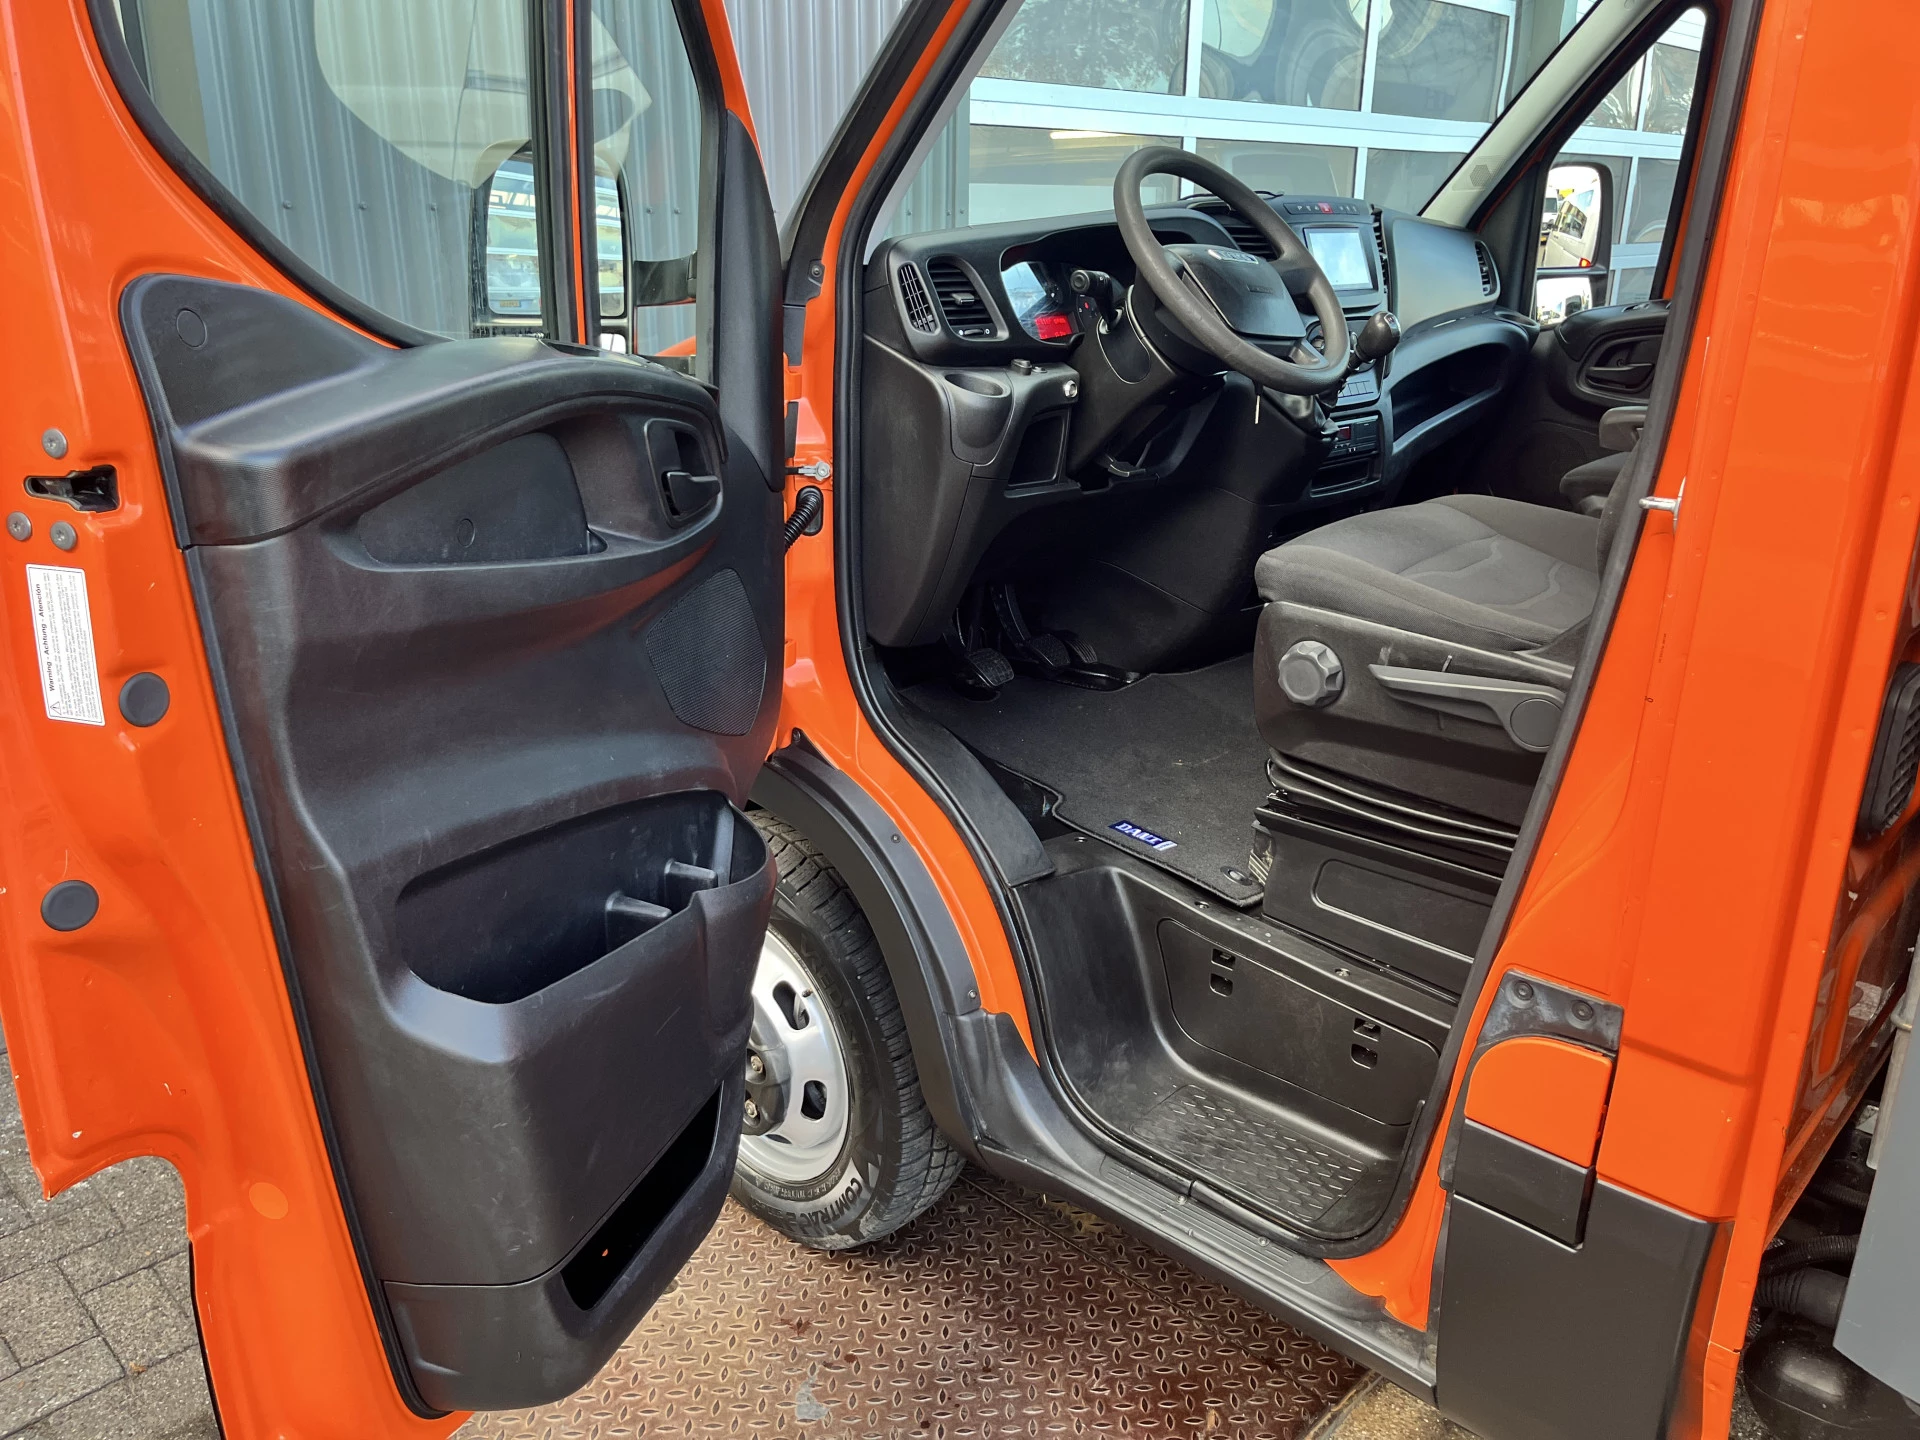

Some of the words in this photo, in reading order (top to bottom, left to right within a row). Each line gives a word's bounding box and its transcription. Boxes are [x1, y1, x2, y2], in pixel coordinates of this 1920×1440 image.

[35, 583, 44, 617] Atención
[41, 623, 50, 655] Achtung
[47, 661, 55, 691] Warning
